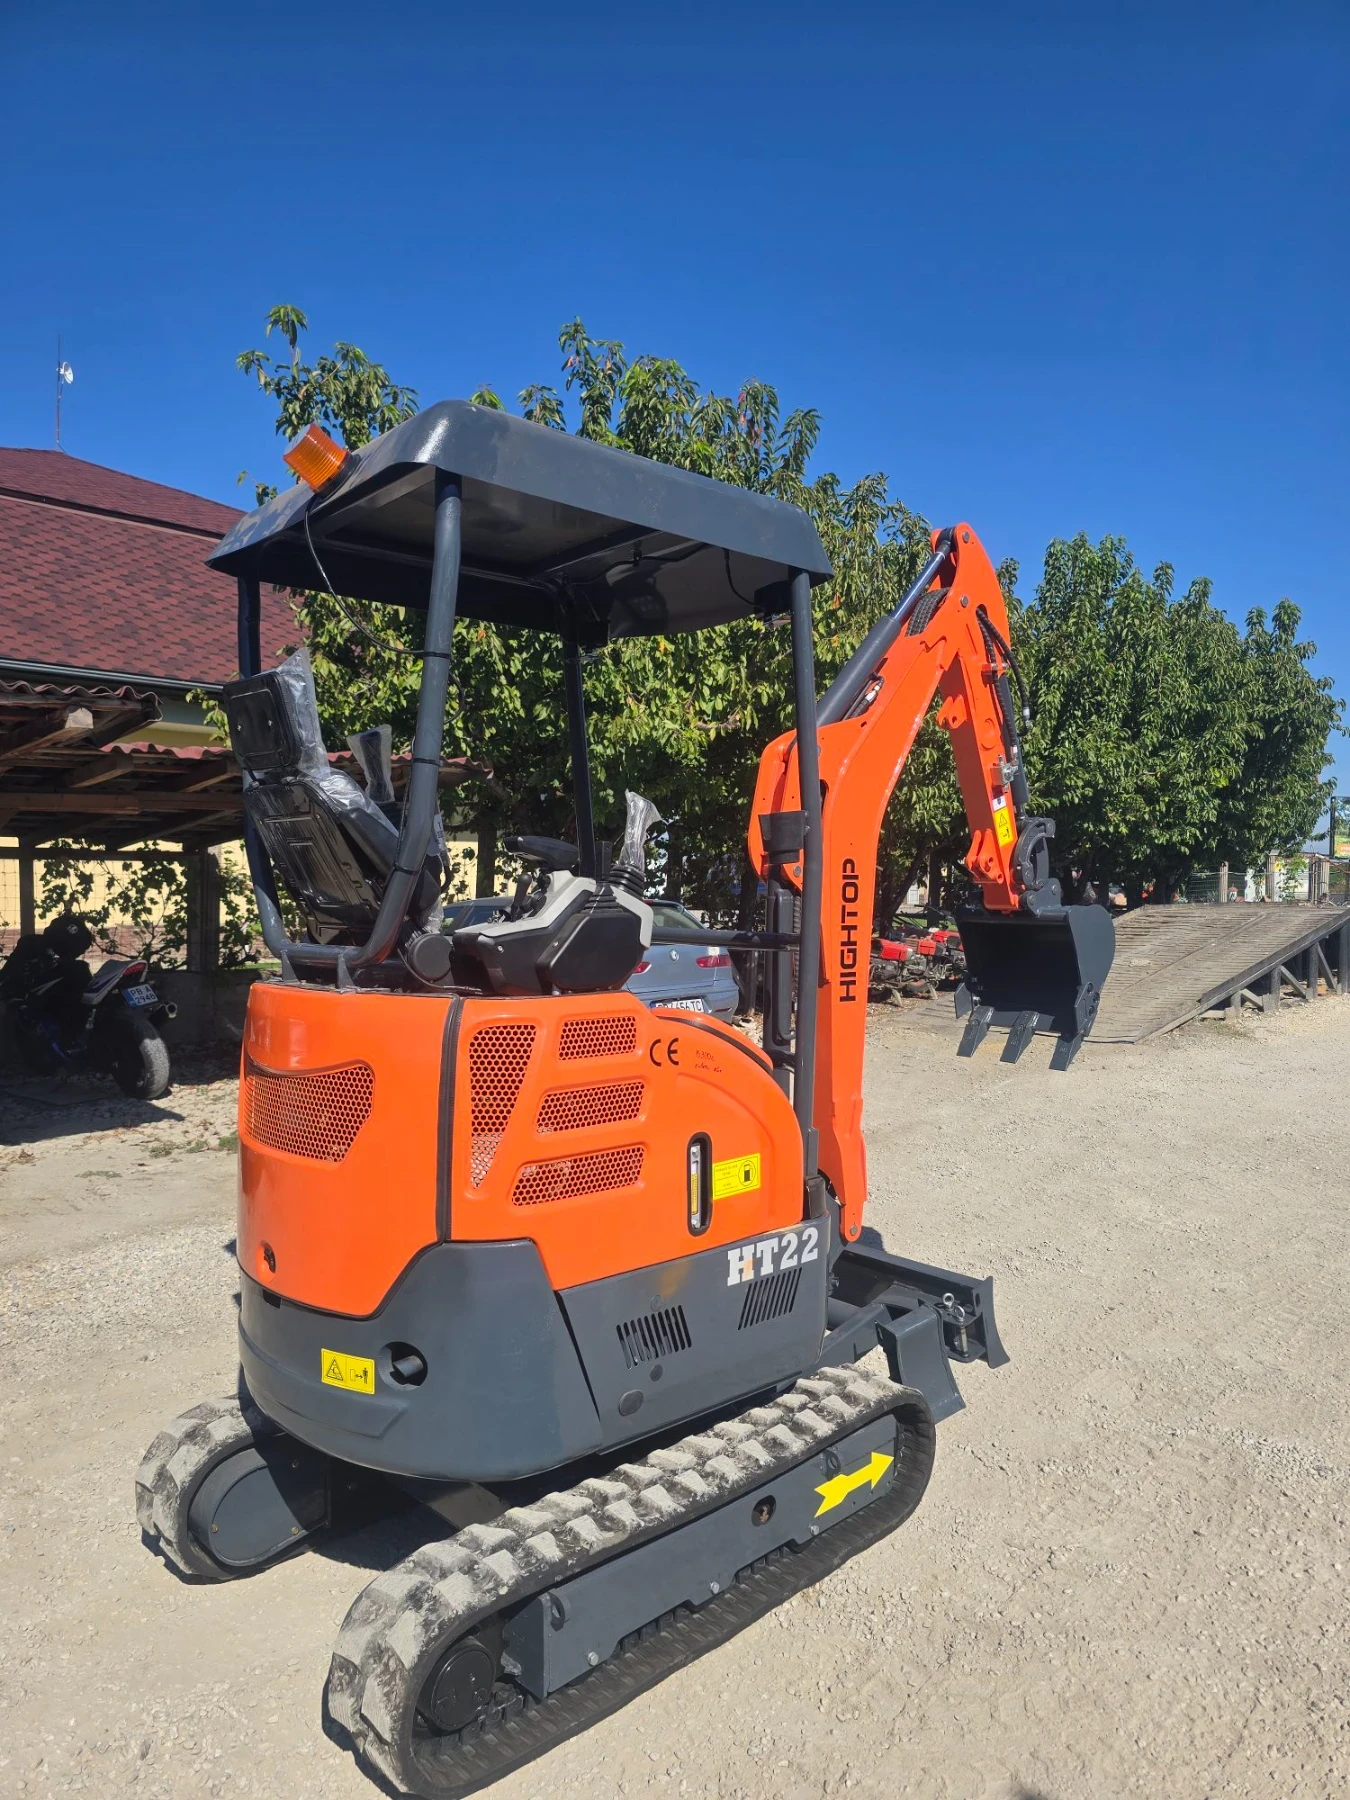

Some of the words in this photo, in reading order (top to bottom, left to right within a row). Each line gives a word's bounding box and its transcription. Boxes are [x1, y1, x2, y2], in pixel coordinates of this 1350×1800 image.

[839, 858, 859, 1002] HIGHTOP
[649, 1037, 679, 1067] CE
[727, 1227, 819, 1287] HT22
